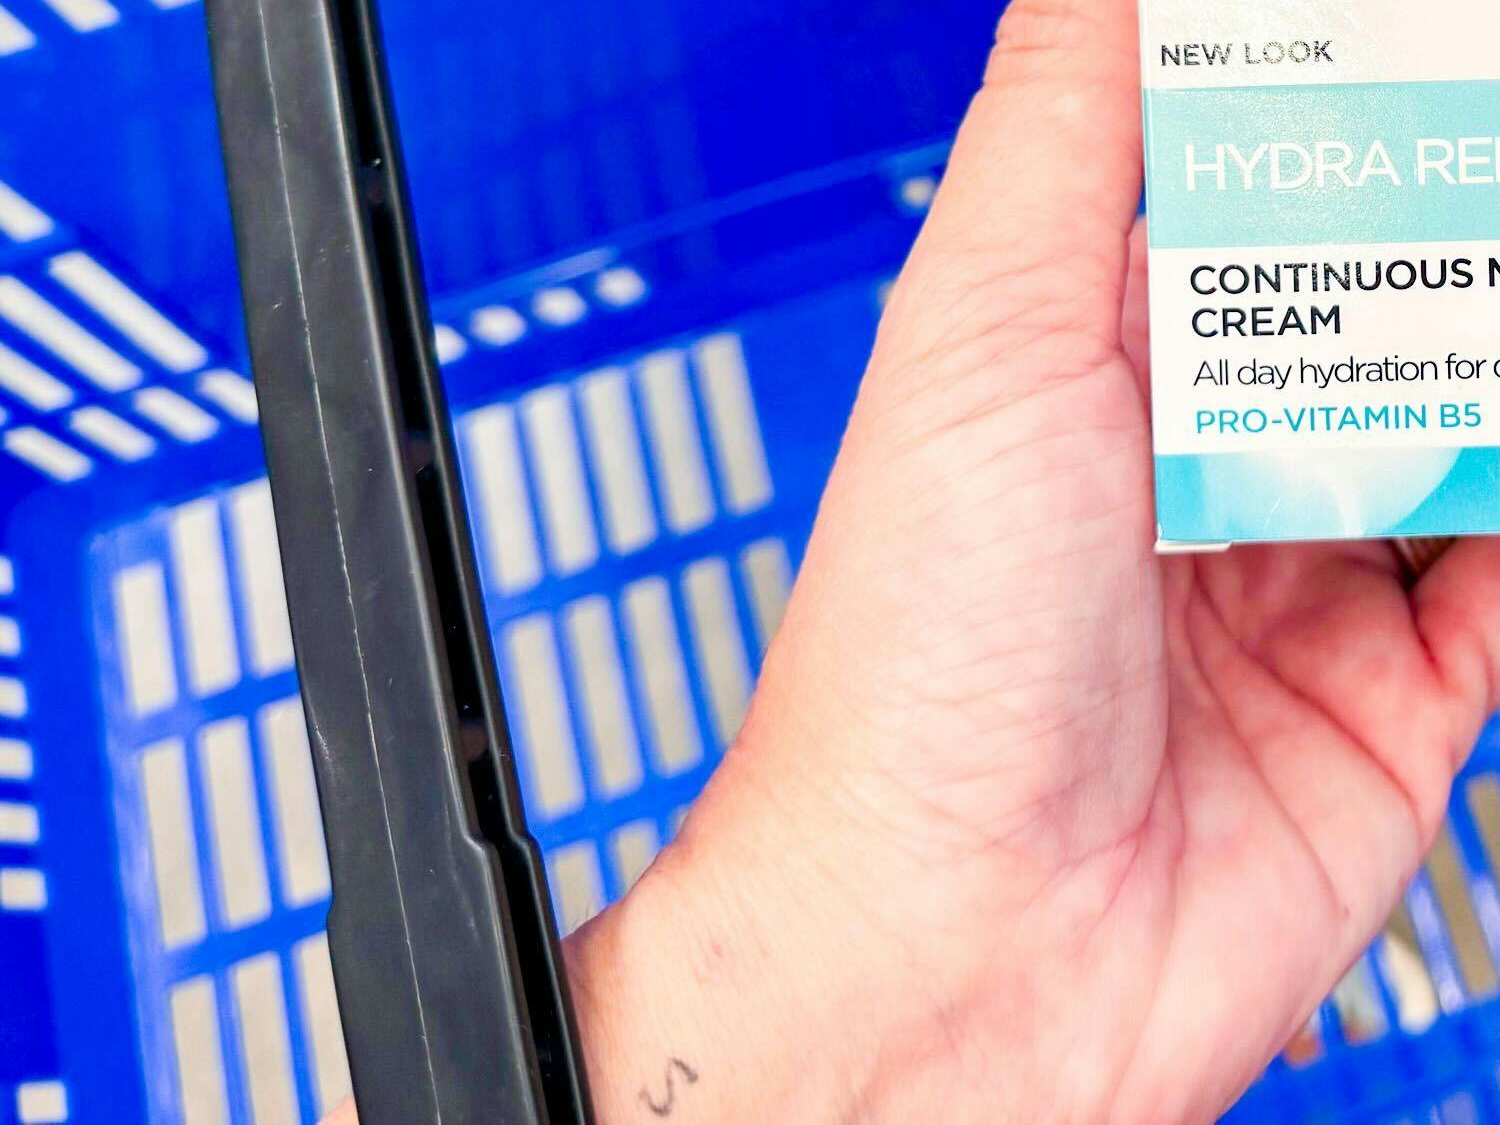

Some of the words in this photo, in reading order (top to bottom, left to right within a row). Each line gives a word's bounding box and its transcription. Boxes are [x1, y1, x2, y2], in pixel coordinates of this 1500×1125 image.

[1161, 42, 1231, 67] NEW
[1245, 40, 1334, 65] LOOK
[1184, 136, 1401, 192] HYDRA
[1190, 258, 1474, 296] CONTINUOUS
[1191, 304, 1342, 338] CREAM
[1193, 359, 1230, 387] All
[1237, 357, 1293, 390] day
[1299, 354, 1439, 389] hydration
[1444, 352, 1487, 380] for
[1195, 404, 1428, 434] PRO-VITAMIN
[1439, 402, 1482, 428] B5
